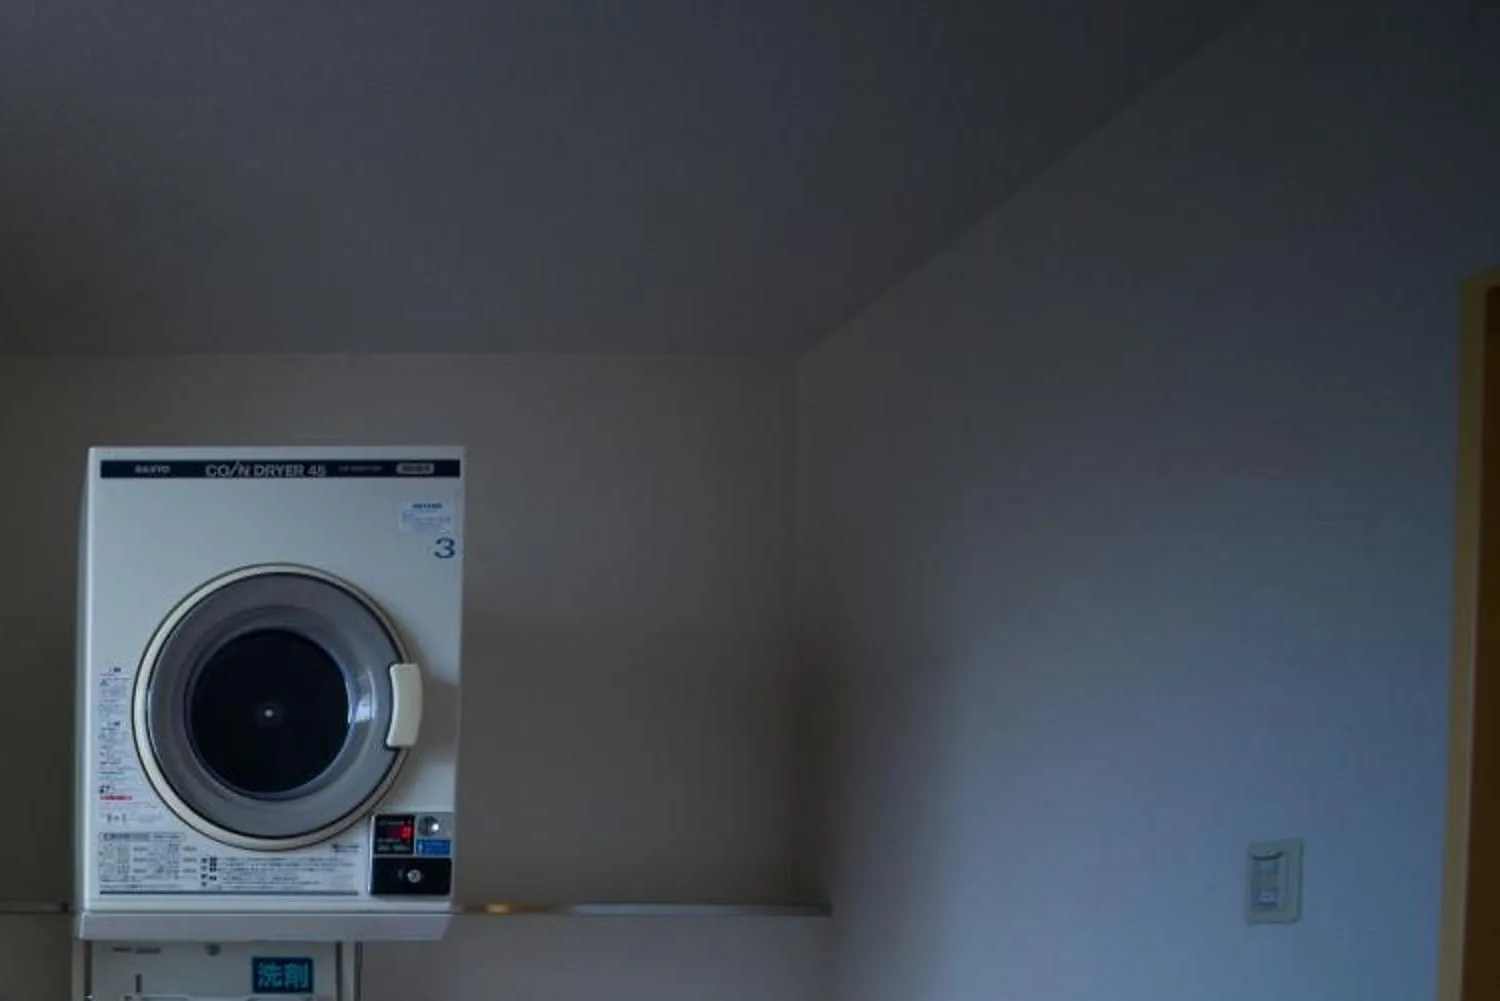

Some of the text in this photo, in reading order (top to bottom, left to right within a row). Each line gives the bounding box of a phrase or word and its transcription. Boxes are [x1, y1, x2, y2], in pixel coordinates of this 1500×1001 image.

[253, 462, 304, 477] DRYER
[306, 463, 327, 477] 45
[433, 537, 456, 559] 3
[257, 961, 310, 990] 洗剤
